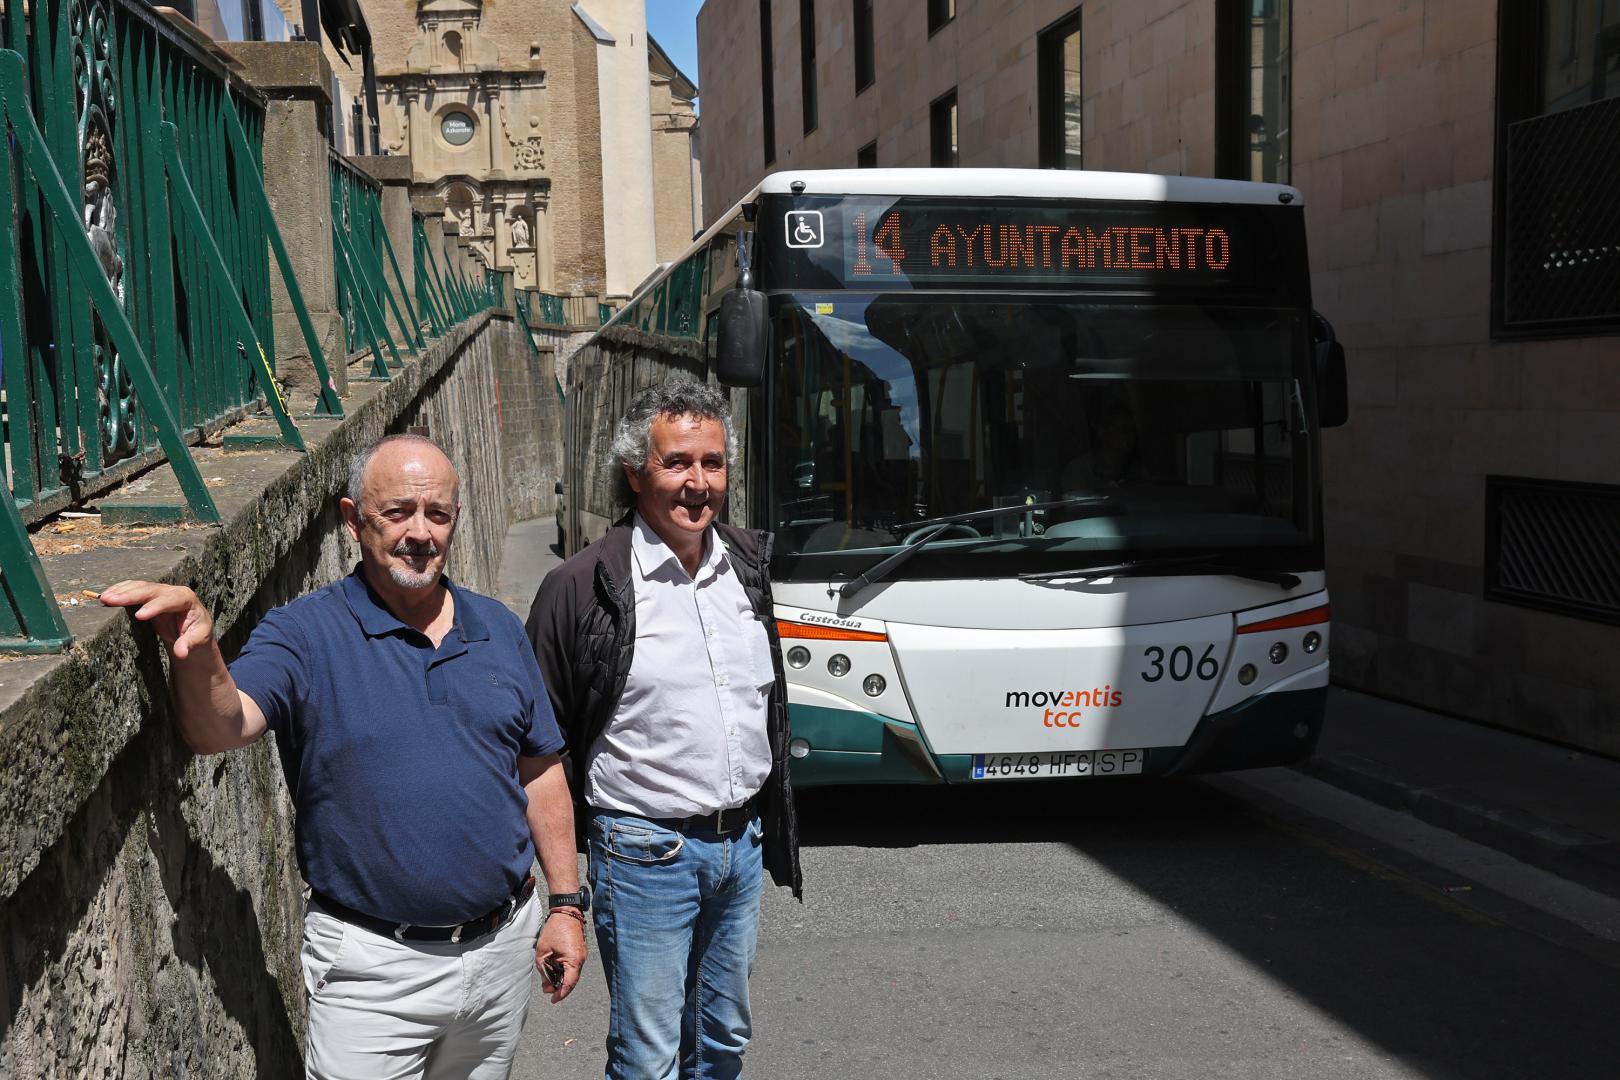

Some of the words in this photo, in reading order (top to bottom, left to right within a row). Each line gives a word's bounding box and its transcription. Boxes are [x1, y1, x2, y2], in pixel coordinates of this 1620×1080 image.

[853, 212, 907, 275] 14
[930, 223, 1230, 270] AYUNTAMIENTO
[800, 612, 863, 628] Castrosua
[1141, 643, 1219, 683] 306
[1005, 685, 1123, 708] moventis
[1043, 708, 1082, 728] tcc
[986, 755, 1040, 776] 4648
[1050, 753, 1089, 775] HFC
[1101, 752, 1138, 773] SP
